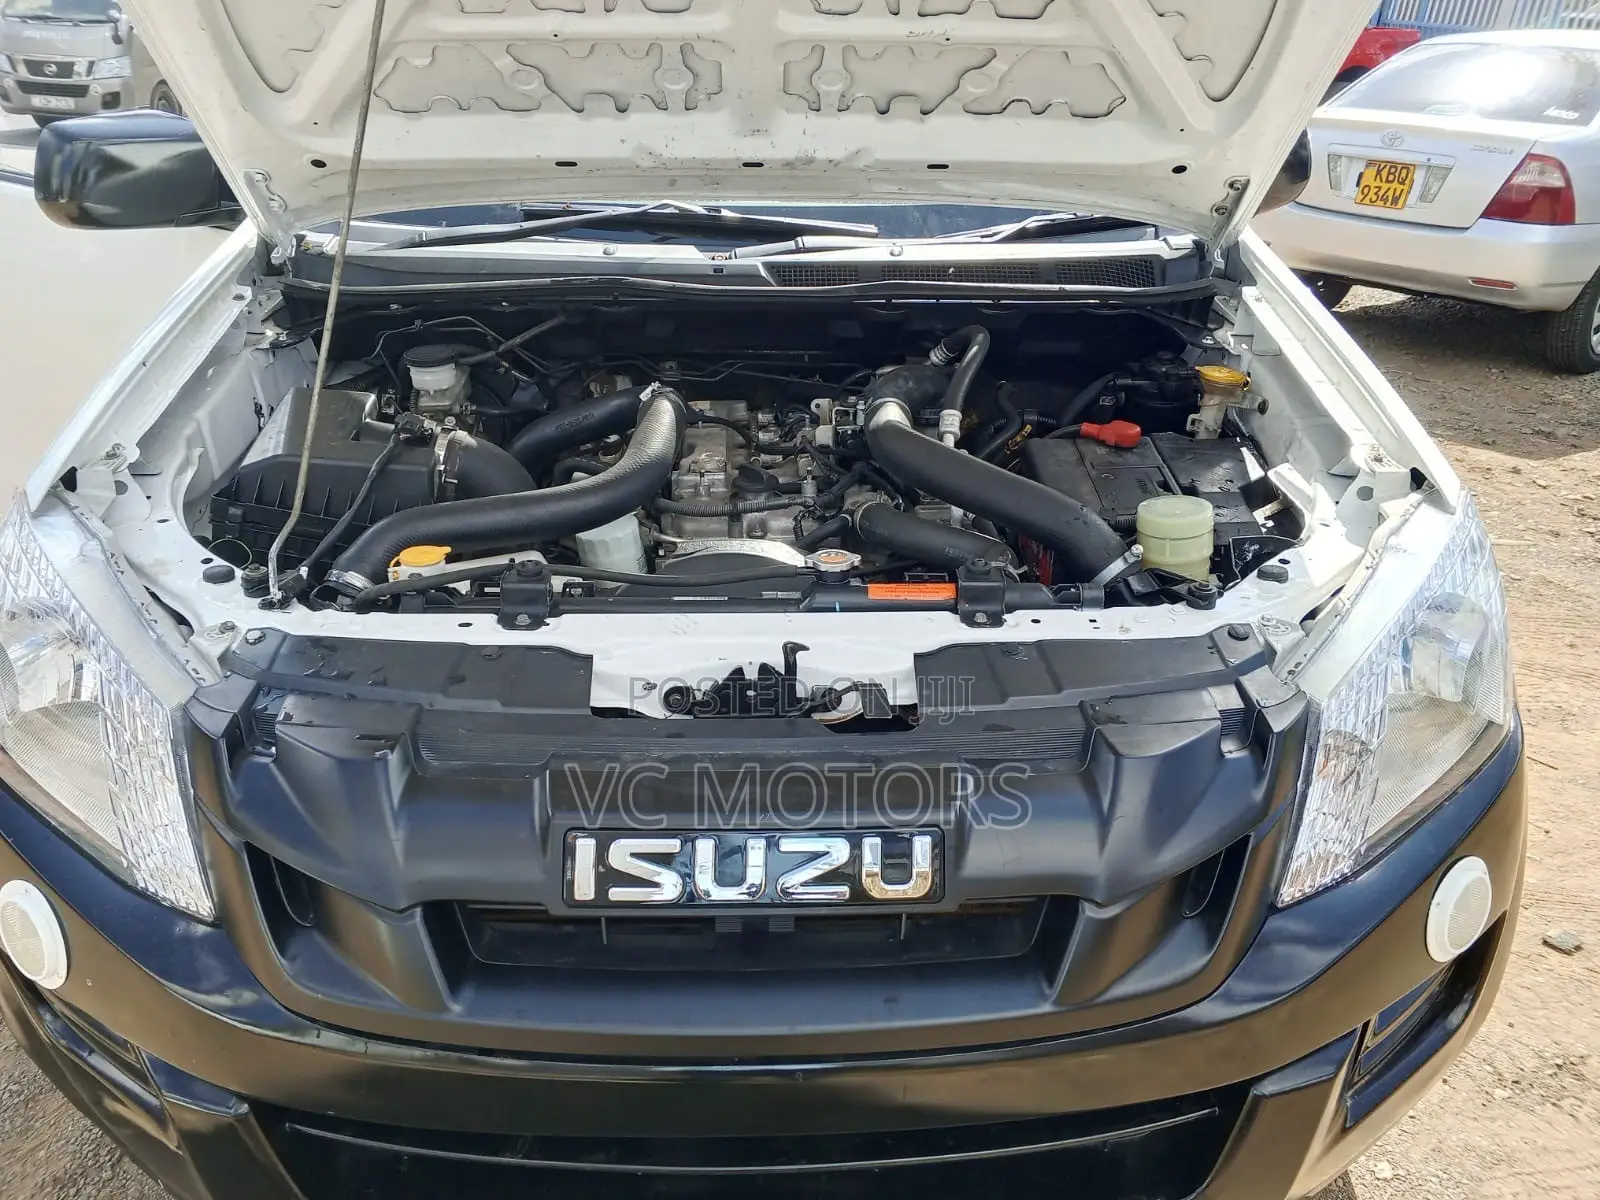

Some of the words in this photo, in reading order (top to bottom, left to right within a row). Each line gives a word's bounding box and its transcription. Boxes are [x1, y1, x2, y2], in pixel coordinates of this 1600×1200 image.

[1374, 163, 1411, 186] KBQ
[1360, 184, 1405, 207] 934W
[572, 834, 934, 903] ISUZU
